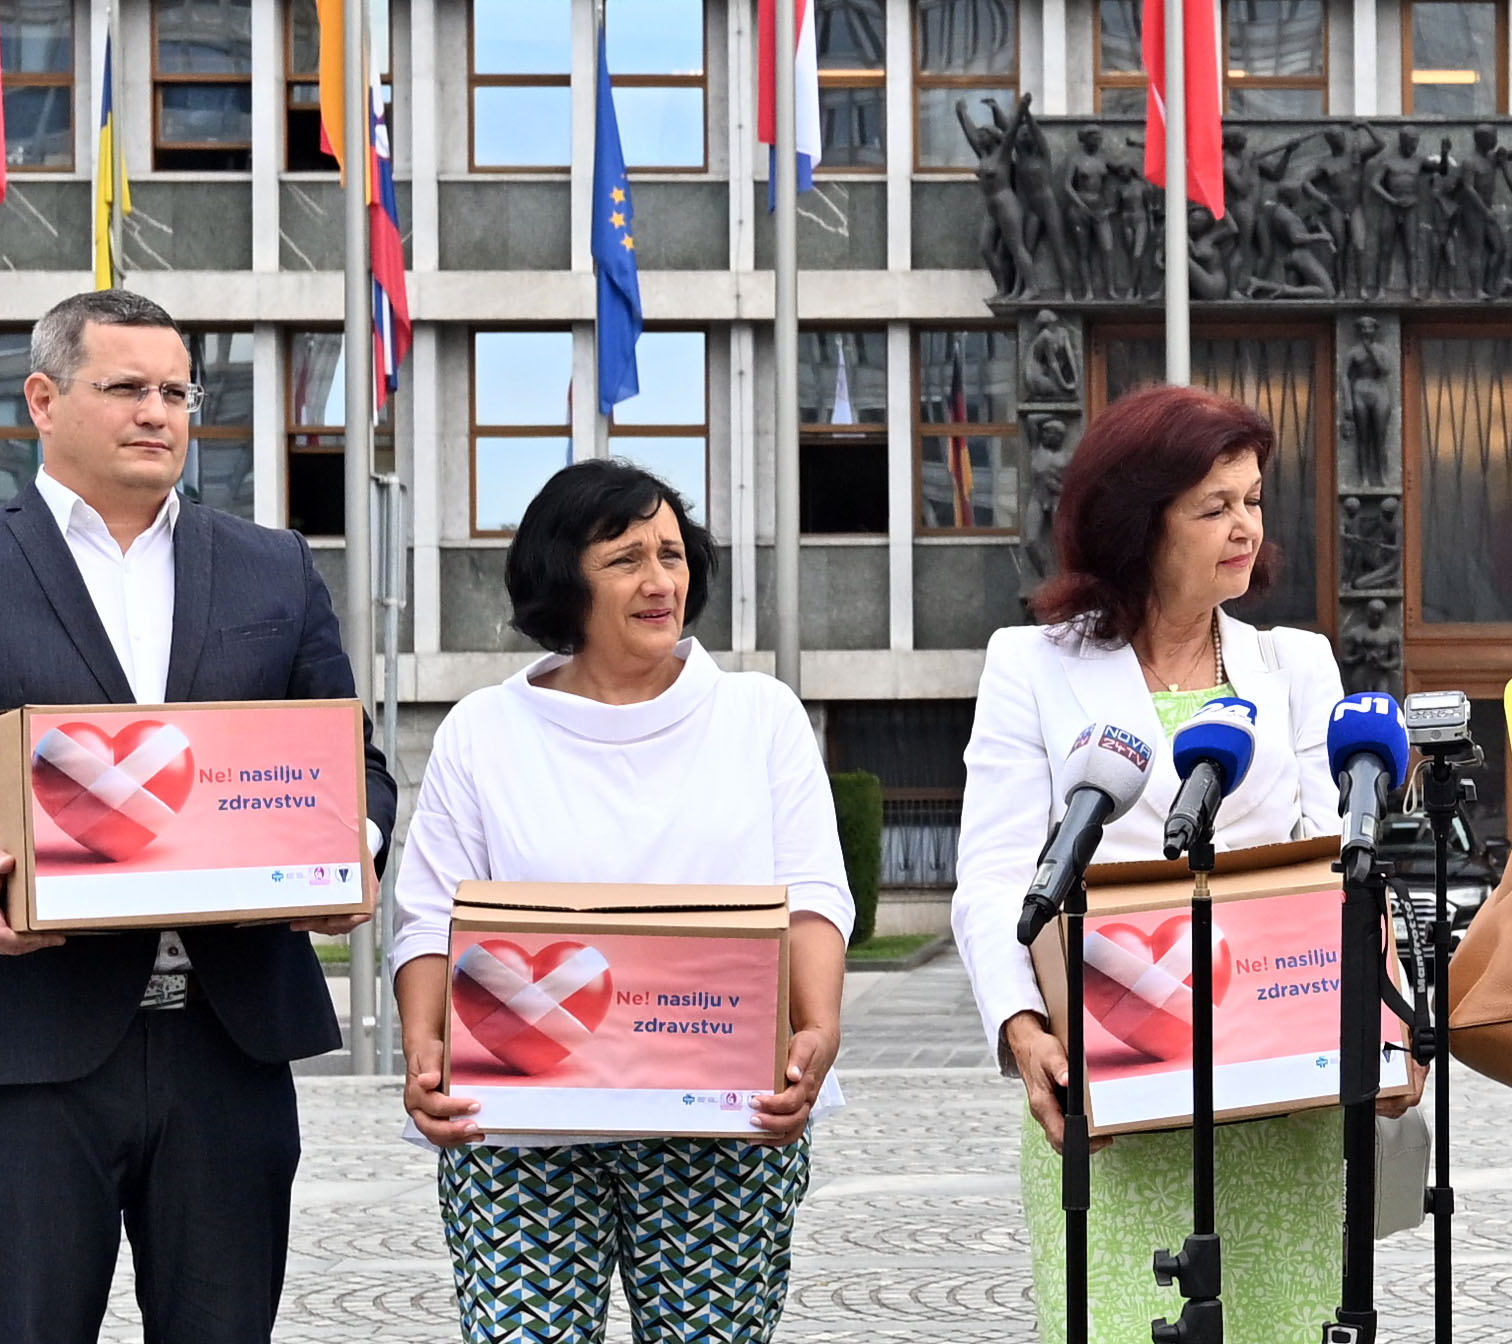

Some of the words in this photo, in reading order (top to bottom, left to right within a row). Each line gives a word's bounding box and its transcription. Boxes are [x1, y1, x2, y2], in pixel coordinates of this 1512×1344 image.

[1333, 696, 1389, 722] N1
[1104, 725, 1152, 760] NOVA
[199, 767, 233, 783] Ne!
[239, 765, 303, 784] nasilju
[309, 768, 320, 780] v
[218, 793, 316, 811] zdravstvu
[1404, 900, 1426, 994] Manfrotto
[1235, 956, 1268, 974] Ne!
[1275, 948, 1338, 969] nasilju
[616, 991, 650, 1005] Ne!
[657, 991, 722, 1009] nasilju
[729, 995, 740, 1007] v
[1257, 977, 1341, 1000] zdravstv
[633, 1017, 733, 1034] zdravstvu
